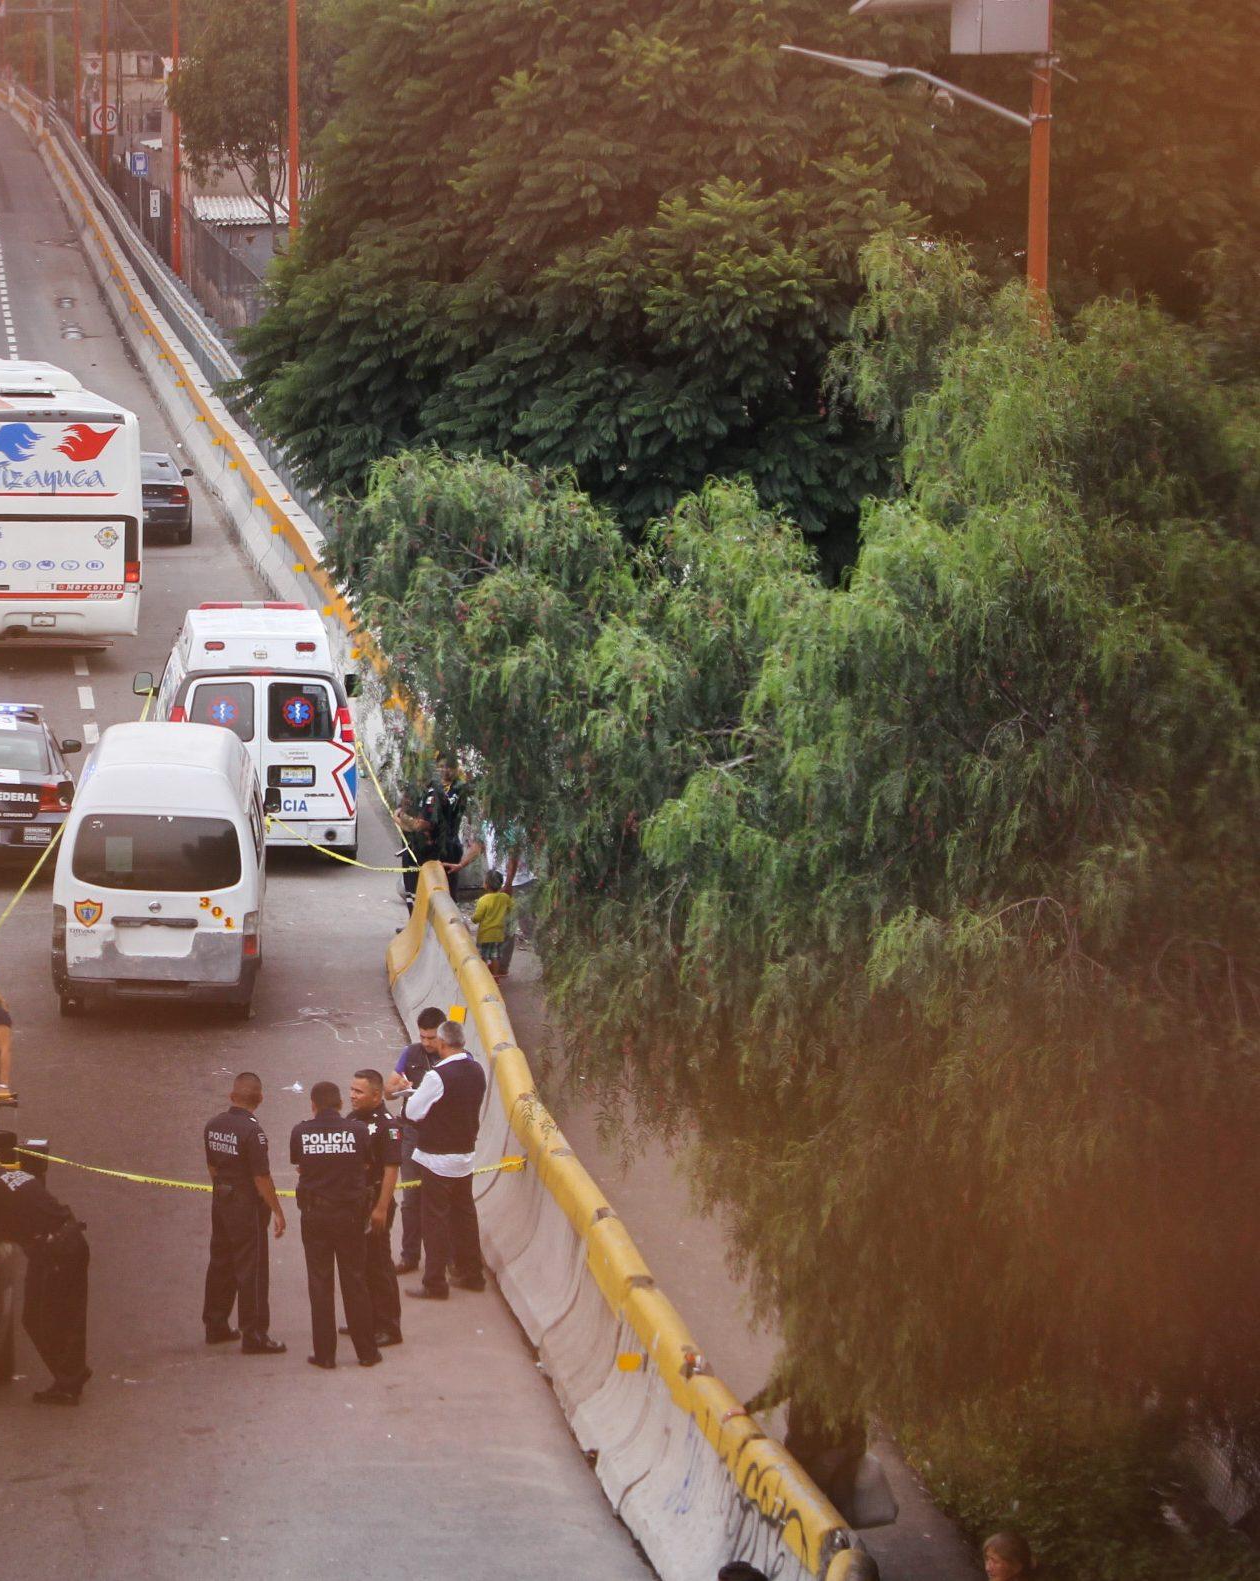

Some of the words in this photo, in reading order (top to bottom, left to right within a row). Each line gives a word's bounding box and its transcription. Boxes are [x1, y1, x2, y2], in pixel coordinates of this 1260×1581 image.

[66, 583, 123, 591] Marcopolo
[209, 1130, 238, 1145] POLICÍA
[302, 1131, 356, 1144] POLICÍA
[209, 1141, 239, 1155] FEDERAL
[303, 1143, 356, 1154] FEDERAL
